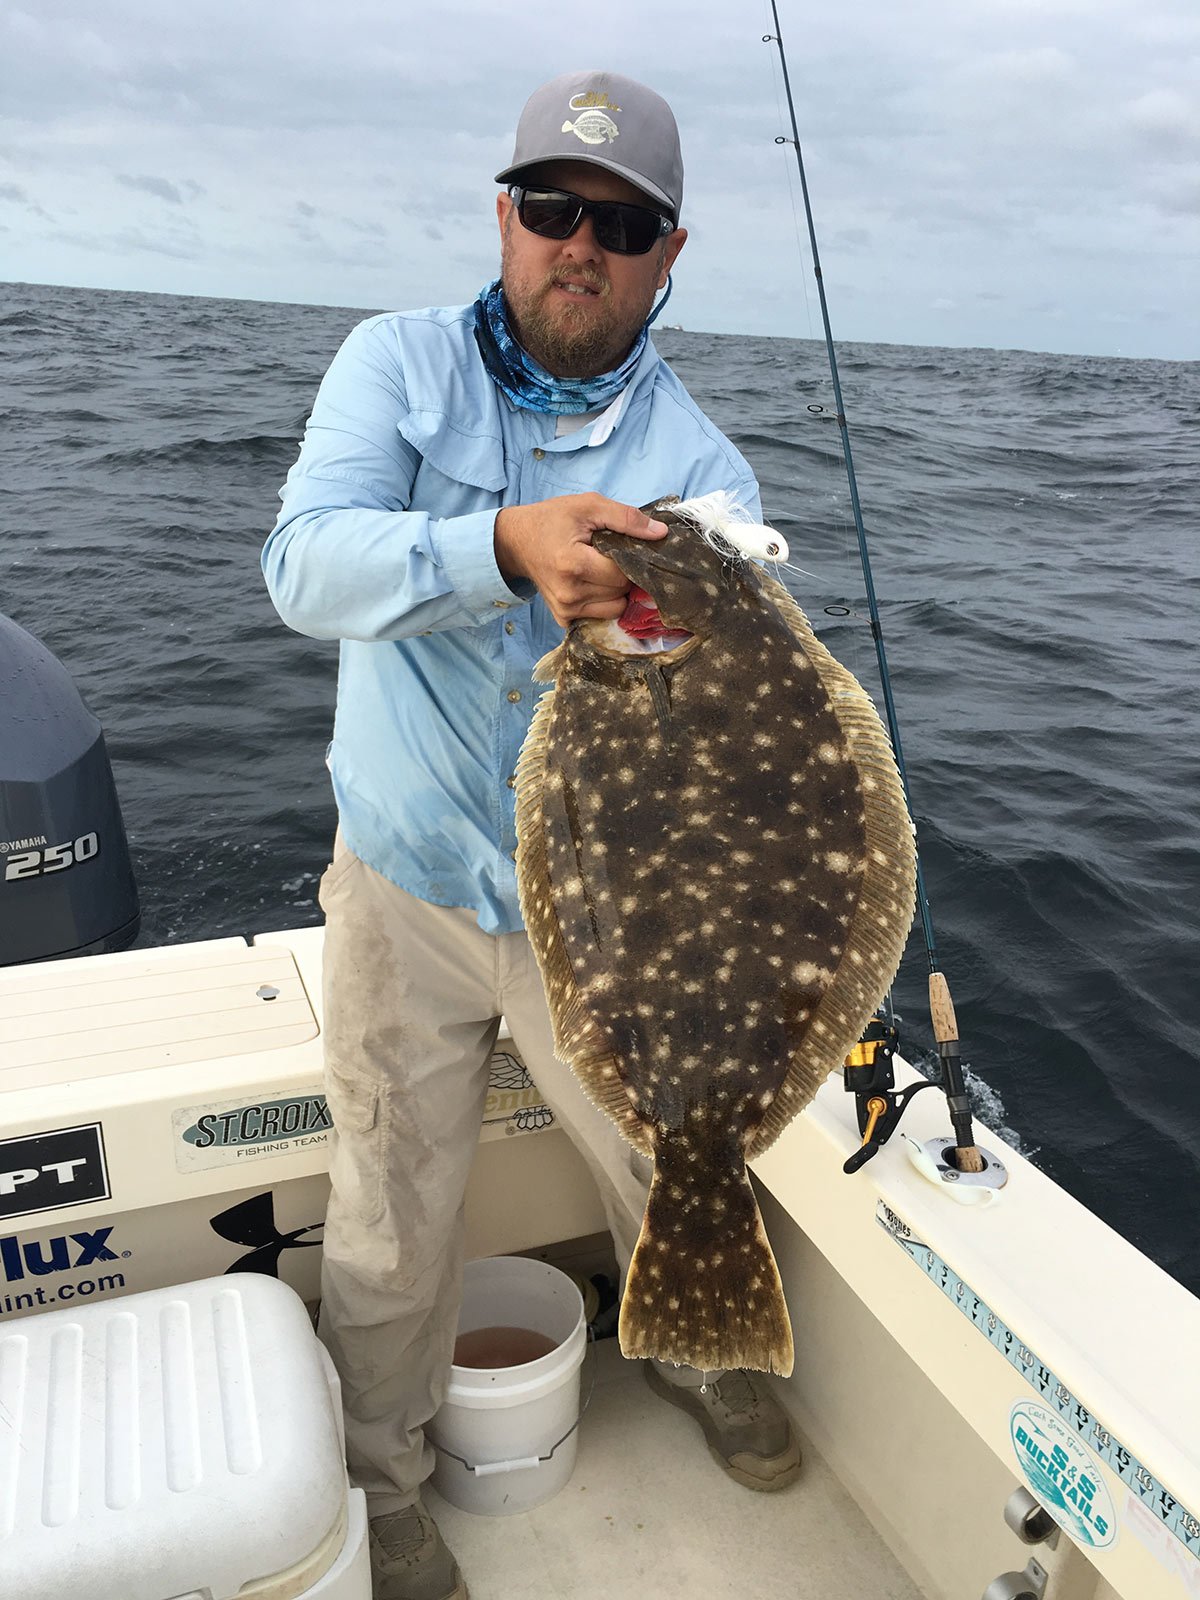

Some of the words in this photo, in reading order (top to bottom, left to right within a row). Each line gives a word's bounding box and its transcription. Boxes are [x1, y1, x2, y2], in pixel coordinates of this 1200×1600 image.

[5, 831, 98, 881] 250
[9, 835, 48, 851] YAMAHA
[237, 1141, 290, 1158] FISHING
[293, 1134, 328, 1148] TEAM
[0, 1157, 87, 1196] PT
[0, 1226, 120, 1283] lux
[0, 1272, 126, 1314] int.com
[926, 1251, 936, 1265] 4
[941, 1265, 949, 1278] 5
[956, 1281, 965, 1297] 6
[973, 1297, 981, 1310] 7
[987, 1313, 997, 1330] 8
[1005, 1331, 1013, 1344] 9
[1017, 1344, 1035, 1368] 10
[1037, 1366, 1051, 1386] 11
[1055, 1383, 1071, 1407] 12
[1075, 1404, 1089, 1424] 13
[1093, 1421, 1112, 1448] 14
[1115, 1445, 1132, 1467] 15
[1135, 1465, 1154, 1492] 16
[1159, 1490, 1177, 1511] 17
[1180, 1511, 1200, 1539] 18
[1015, 1425, 1109, 1537] BUCKTAILS
[1051, 1444, 1069, 1471] S
[1067, 1466, 1078, 1482] &
[1077, 1473, 1097, 1501] S
